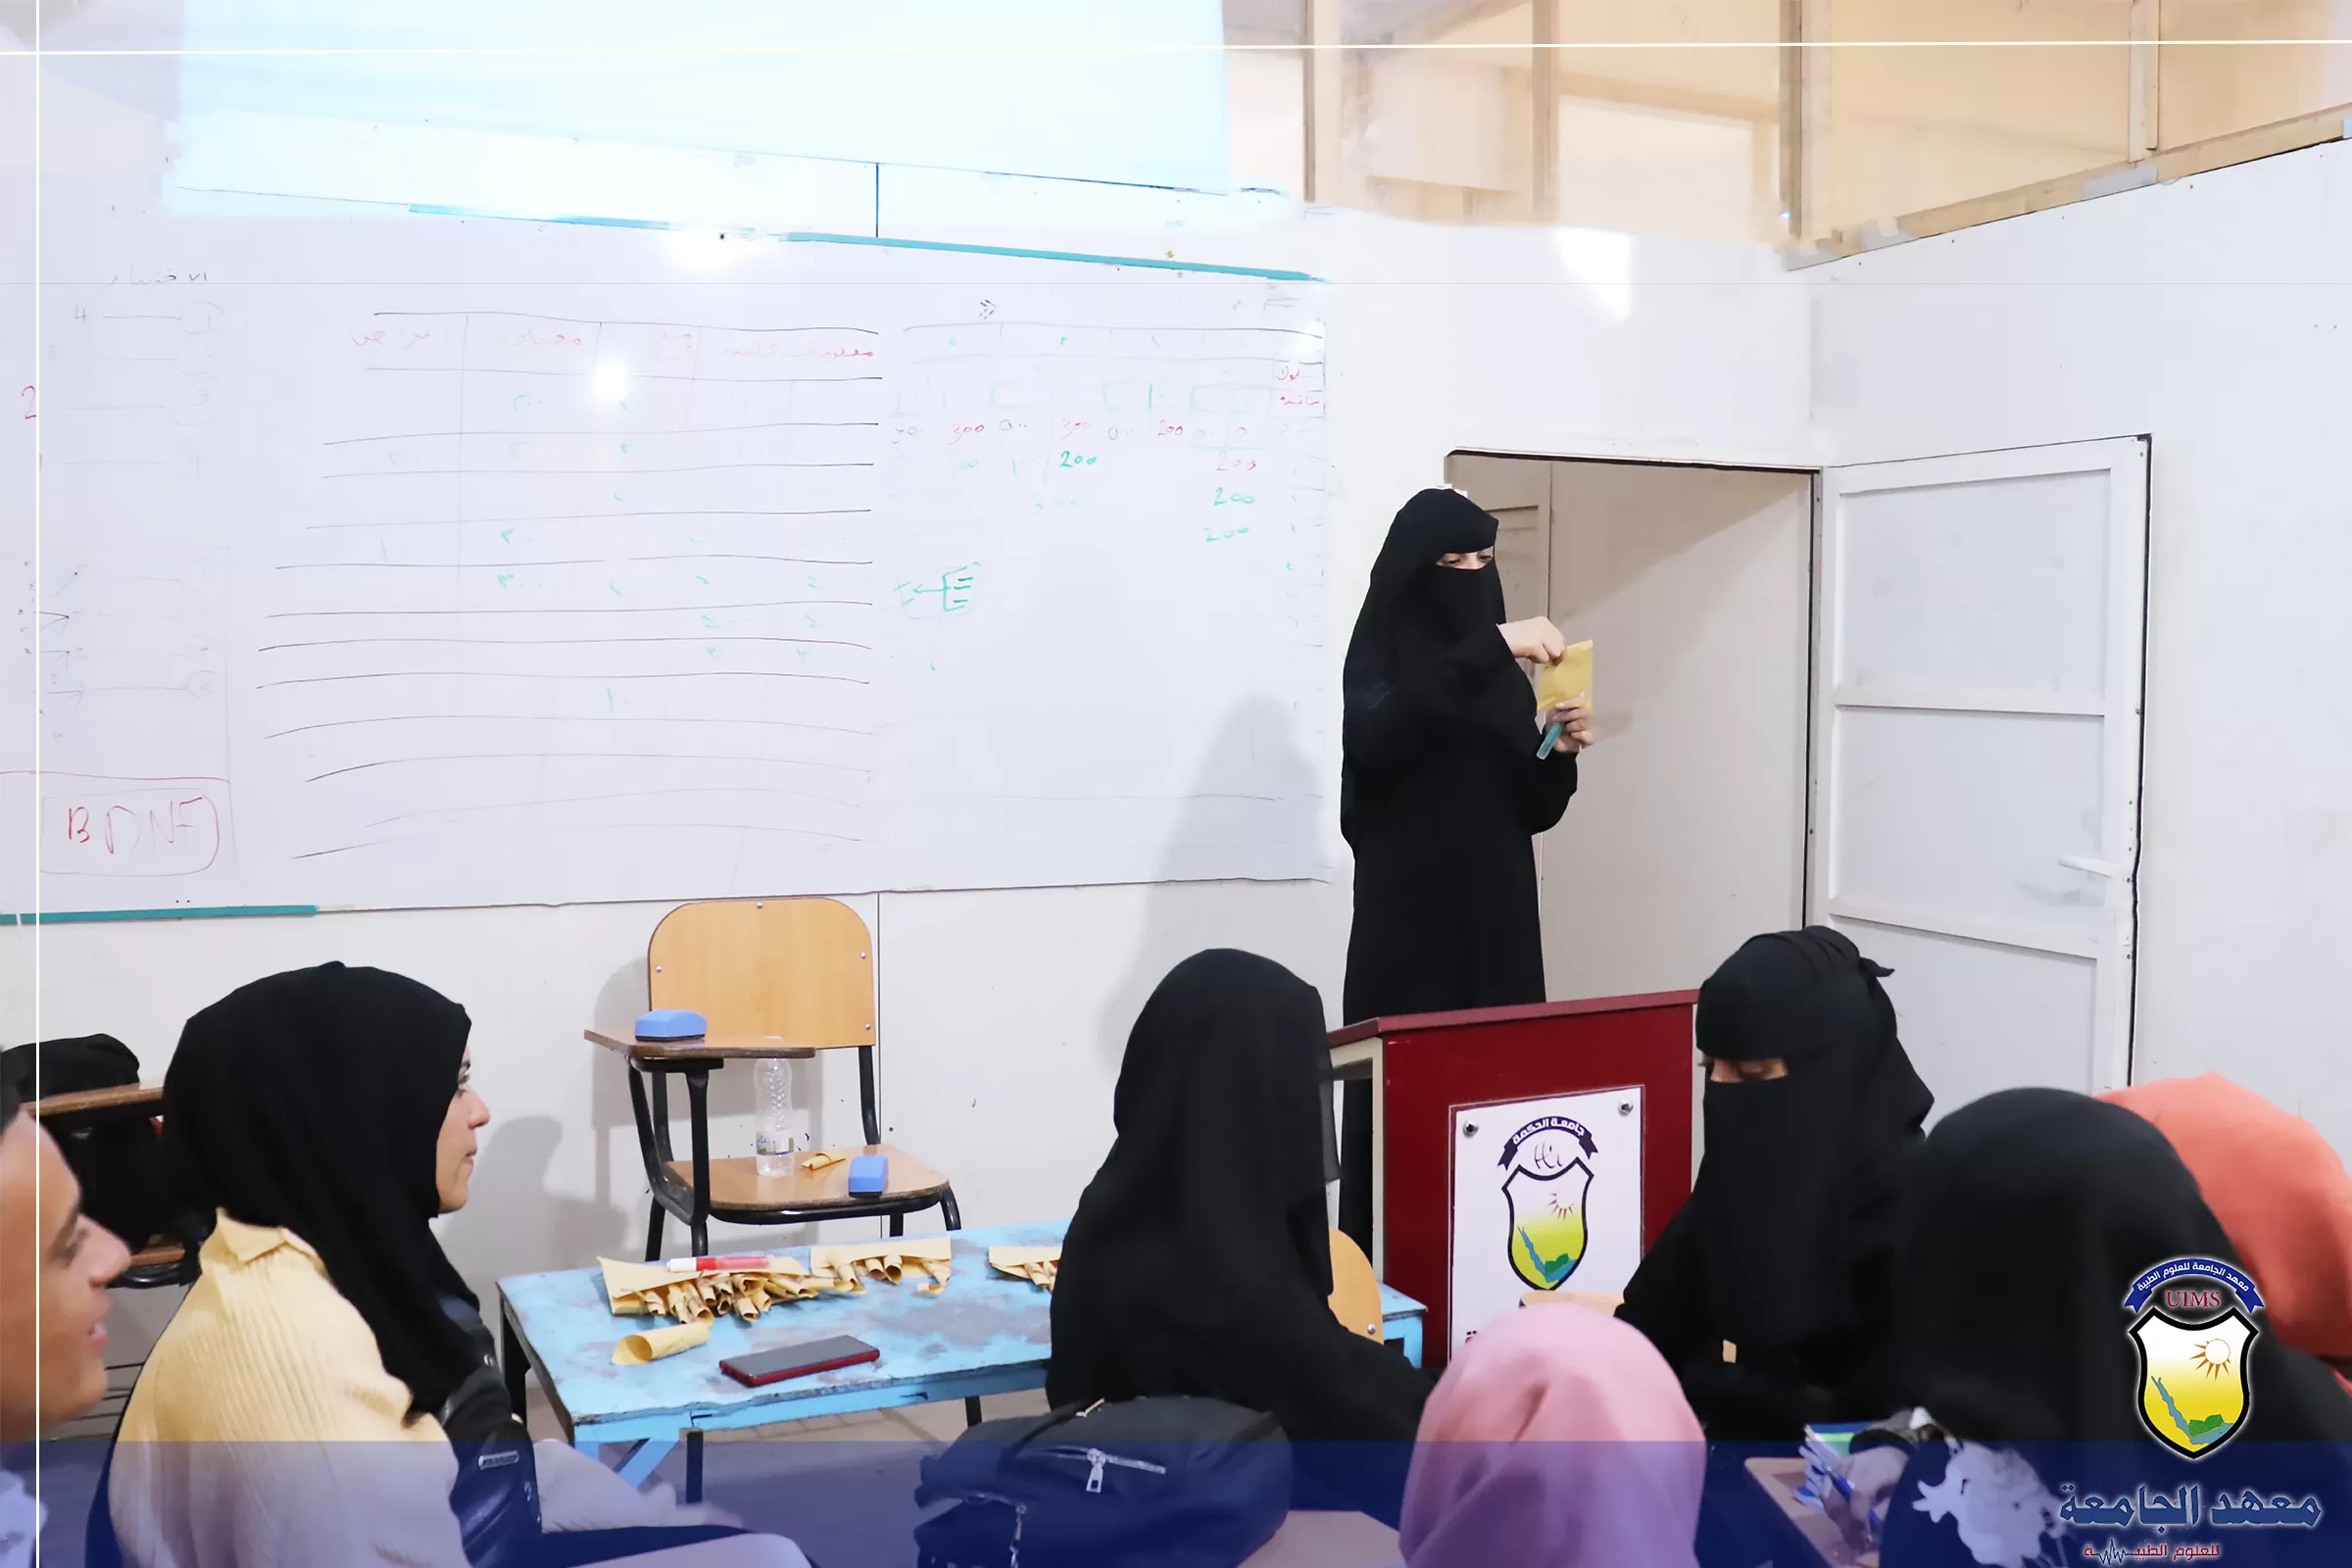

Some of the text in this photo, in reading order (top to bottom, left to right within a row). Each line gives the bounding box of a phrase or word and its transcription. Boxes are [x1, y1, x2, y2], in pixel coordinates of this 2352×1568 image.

[1058, 450, 1099, 468] 200
[1212, 486, 1256, 507] 200
[1202, 526, 1250, 543] 200
[1512, 1117, 1585, 1146] جامعة الحكمة
